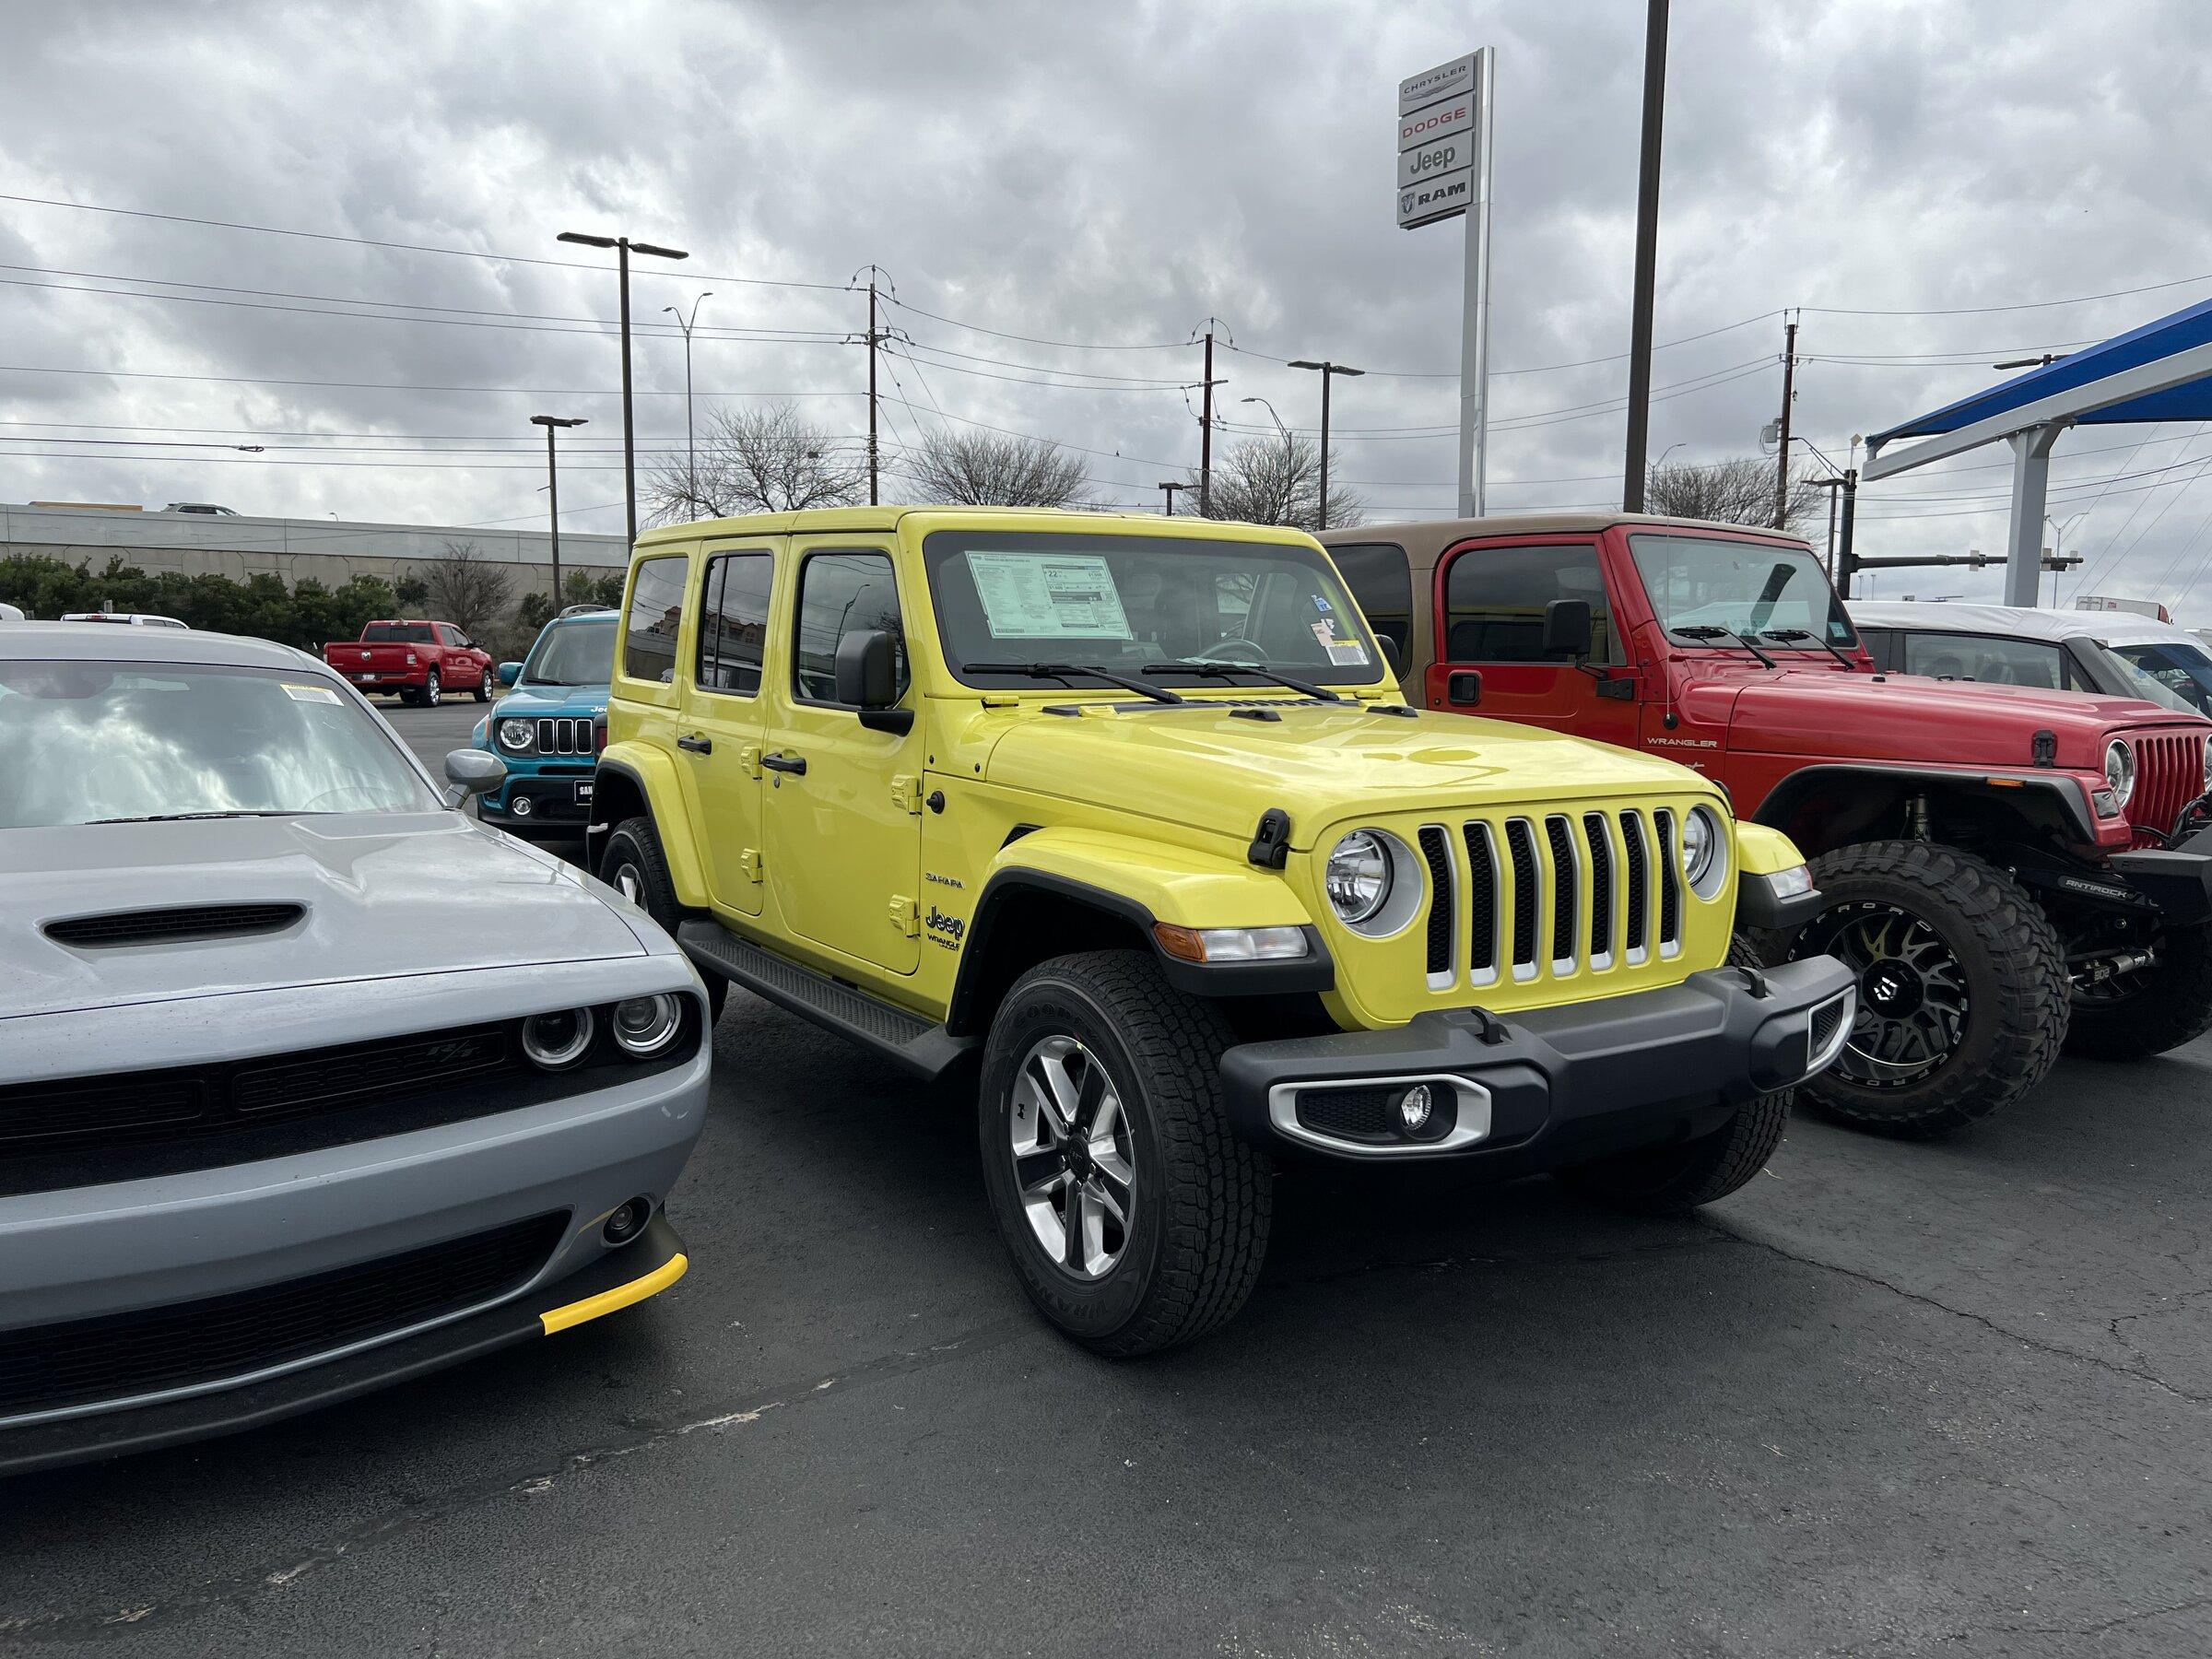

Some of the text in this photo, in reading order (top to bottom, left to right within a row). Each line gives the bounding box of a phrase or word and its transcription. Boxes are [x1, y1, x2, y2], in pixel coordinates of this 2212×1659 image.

[1404, 65, 1466, 94] CHRYSLER
[1403, 107, 1466, 138] DODGE
[1410, 147, 1455, 173] Jeep
[1418, 182, 1465, 206] RAM
[1647, 737, 1717, 747] WRANGLER
[925, 872, 965, 889] SAHARA
[2065, 879, 2127, 898] ANTIROCK
[925, 904, 965, 941] Jeep
